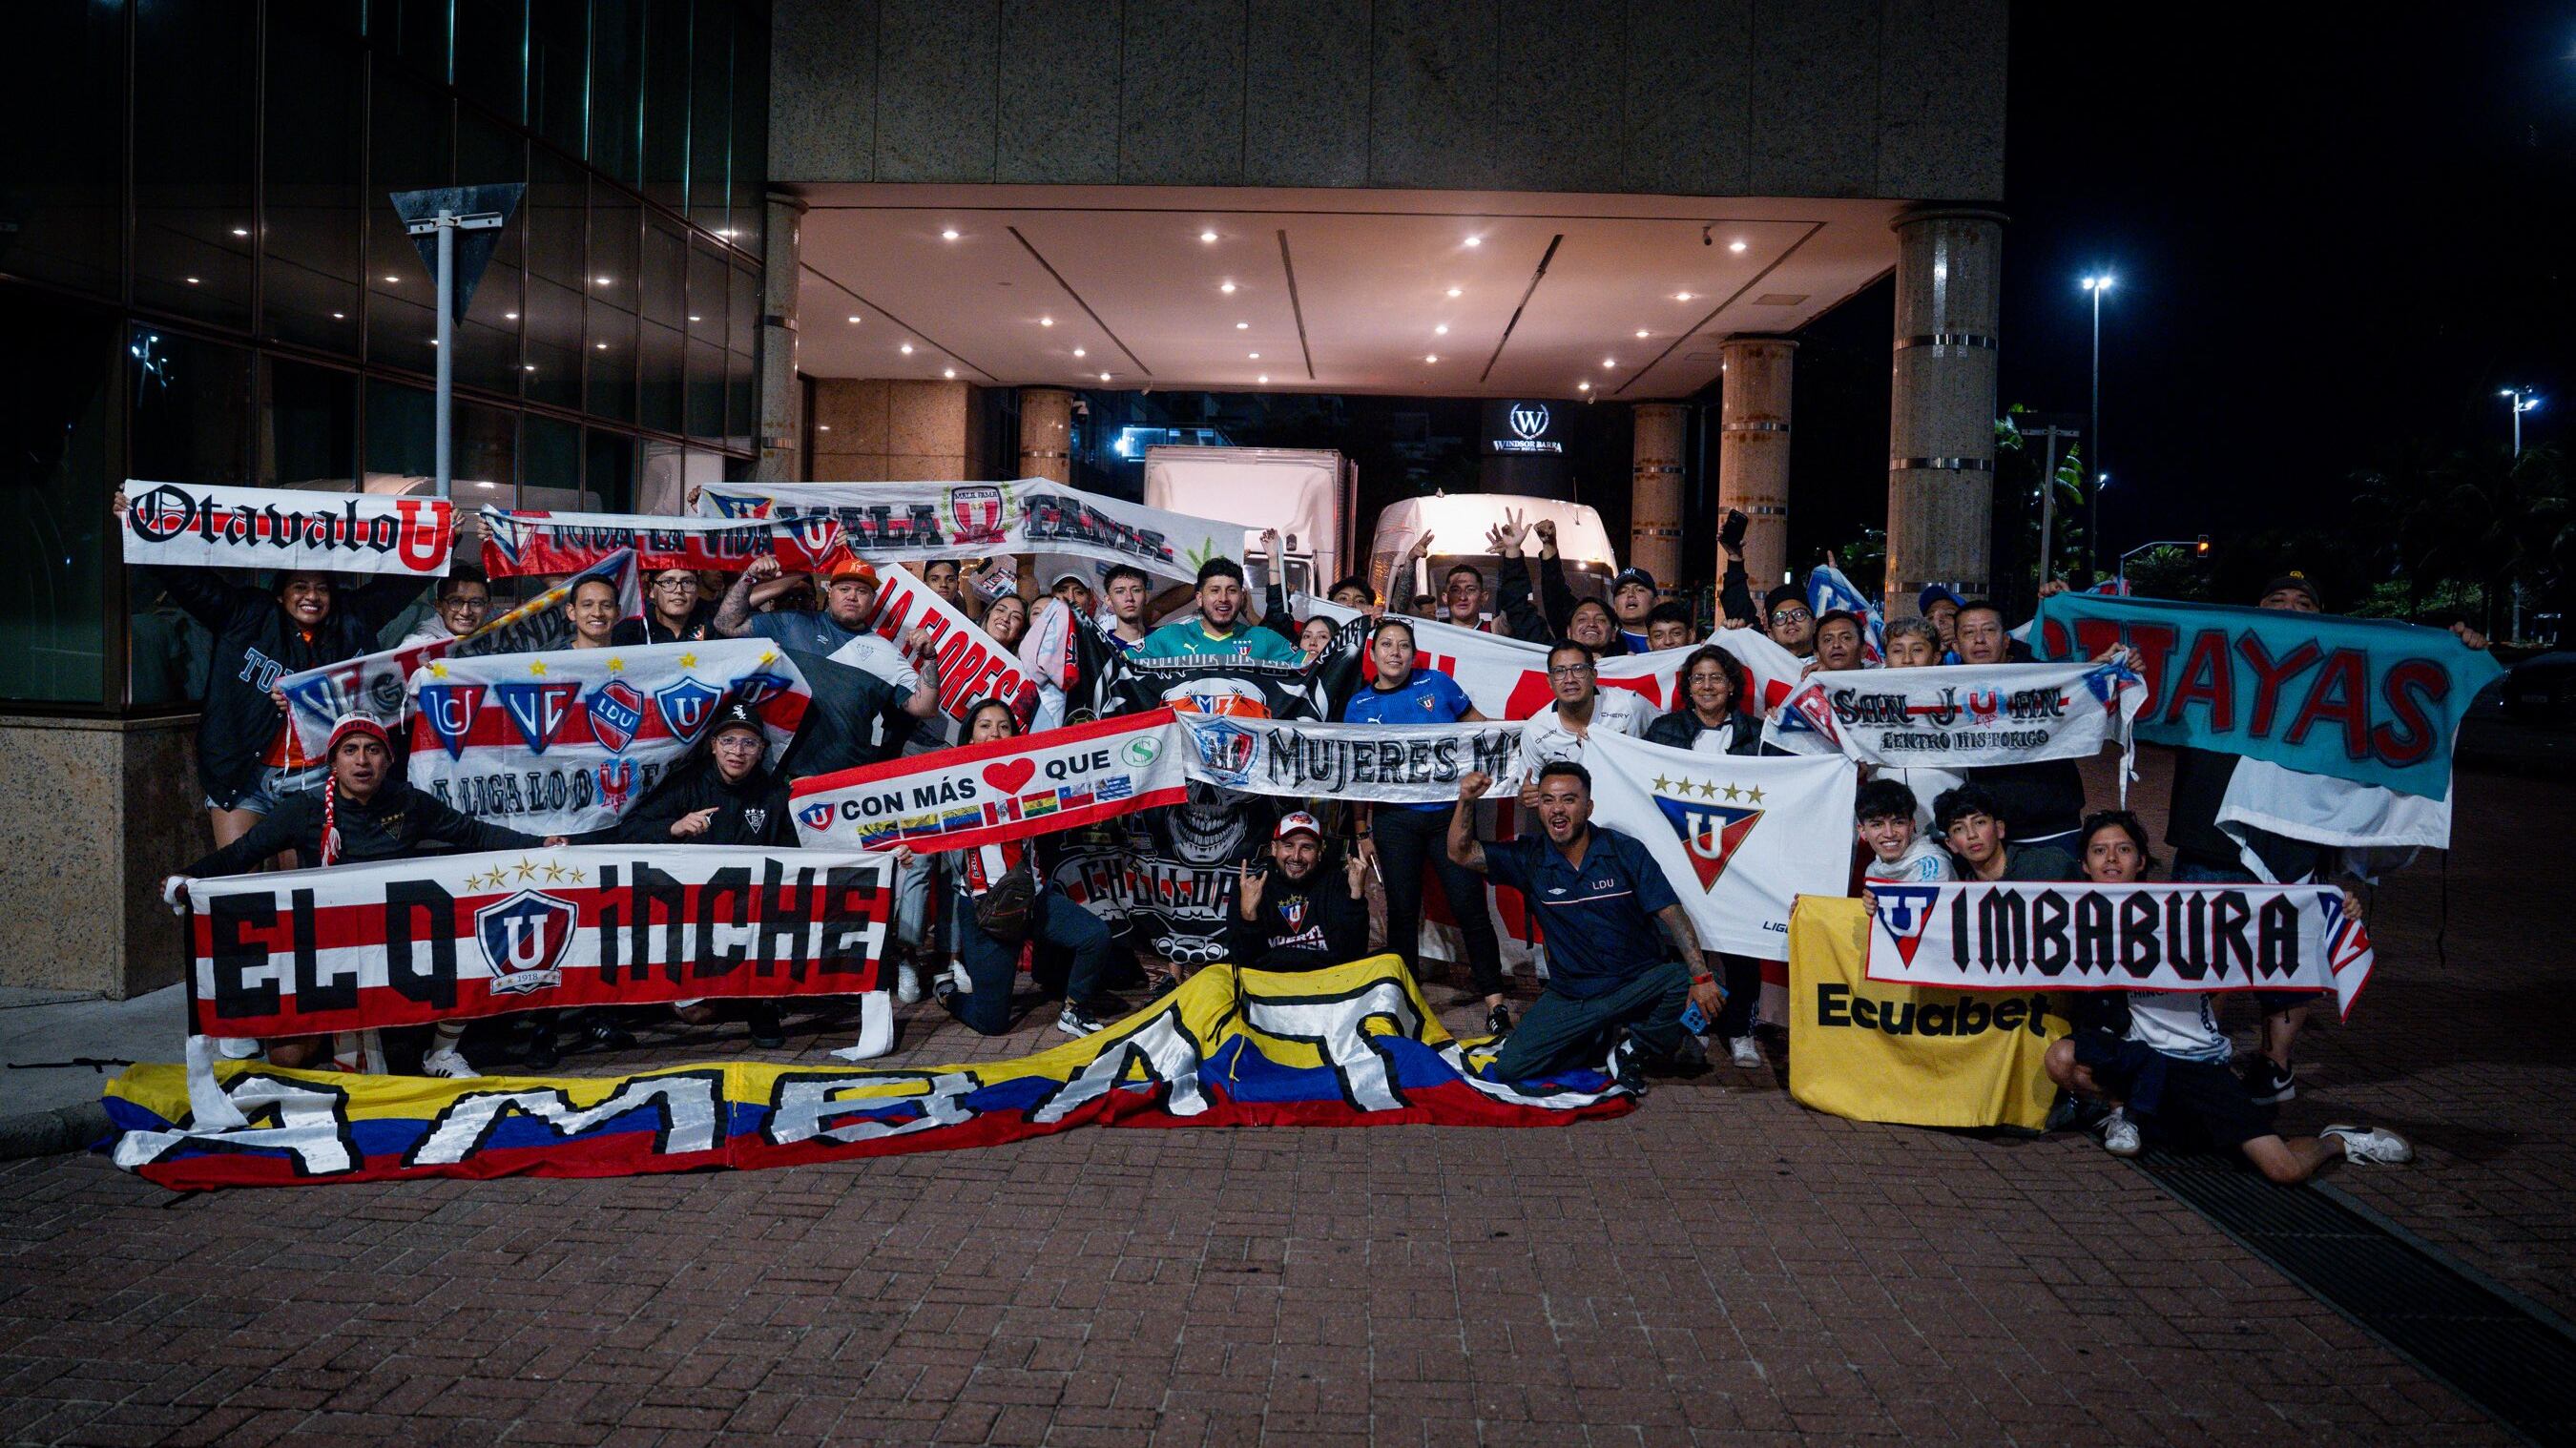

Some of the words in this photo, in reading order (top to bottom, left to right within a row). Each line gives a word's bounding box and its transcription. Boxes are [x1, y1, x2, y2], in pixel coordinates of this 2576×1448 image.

[1516, 411, 1544, 433] W
[1493, 441, 1535, 451] WINDSOR
[1536, 442, 1563, 452] BARRA
[130, 485, 399, 550] Otavalo
[597, 698, 635, 728] LDU
[1535, 728, 1557, 744] CHERY
[1266, 727, 1459, 794] MUJERES
[841, 793, 904, 821] CON
[913, 773, 977, 809] MÁS
[1045, 750, 1111, 779] QUE
[1686, 812, 1728, 859] U
[1592, 879, 1614, 890] LDU
[208, 880, 358, 1019] EL
[1951, 885, 2300, 985] IMBABURA
[516, 972, 541, 983] 1918
[1818, 983, 2051, 1038] Ecuabet
